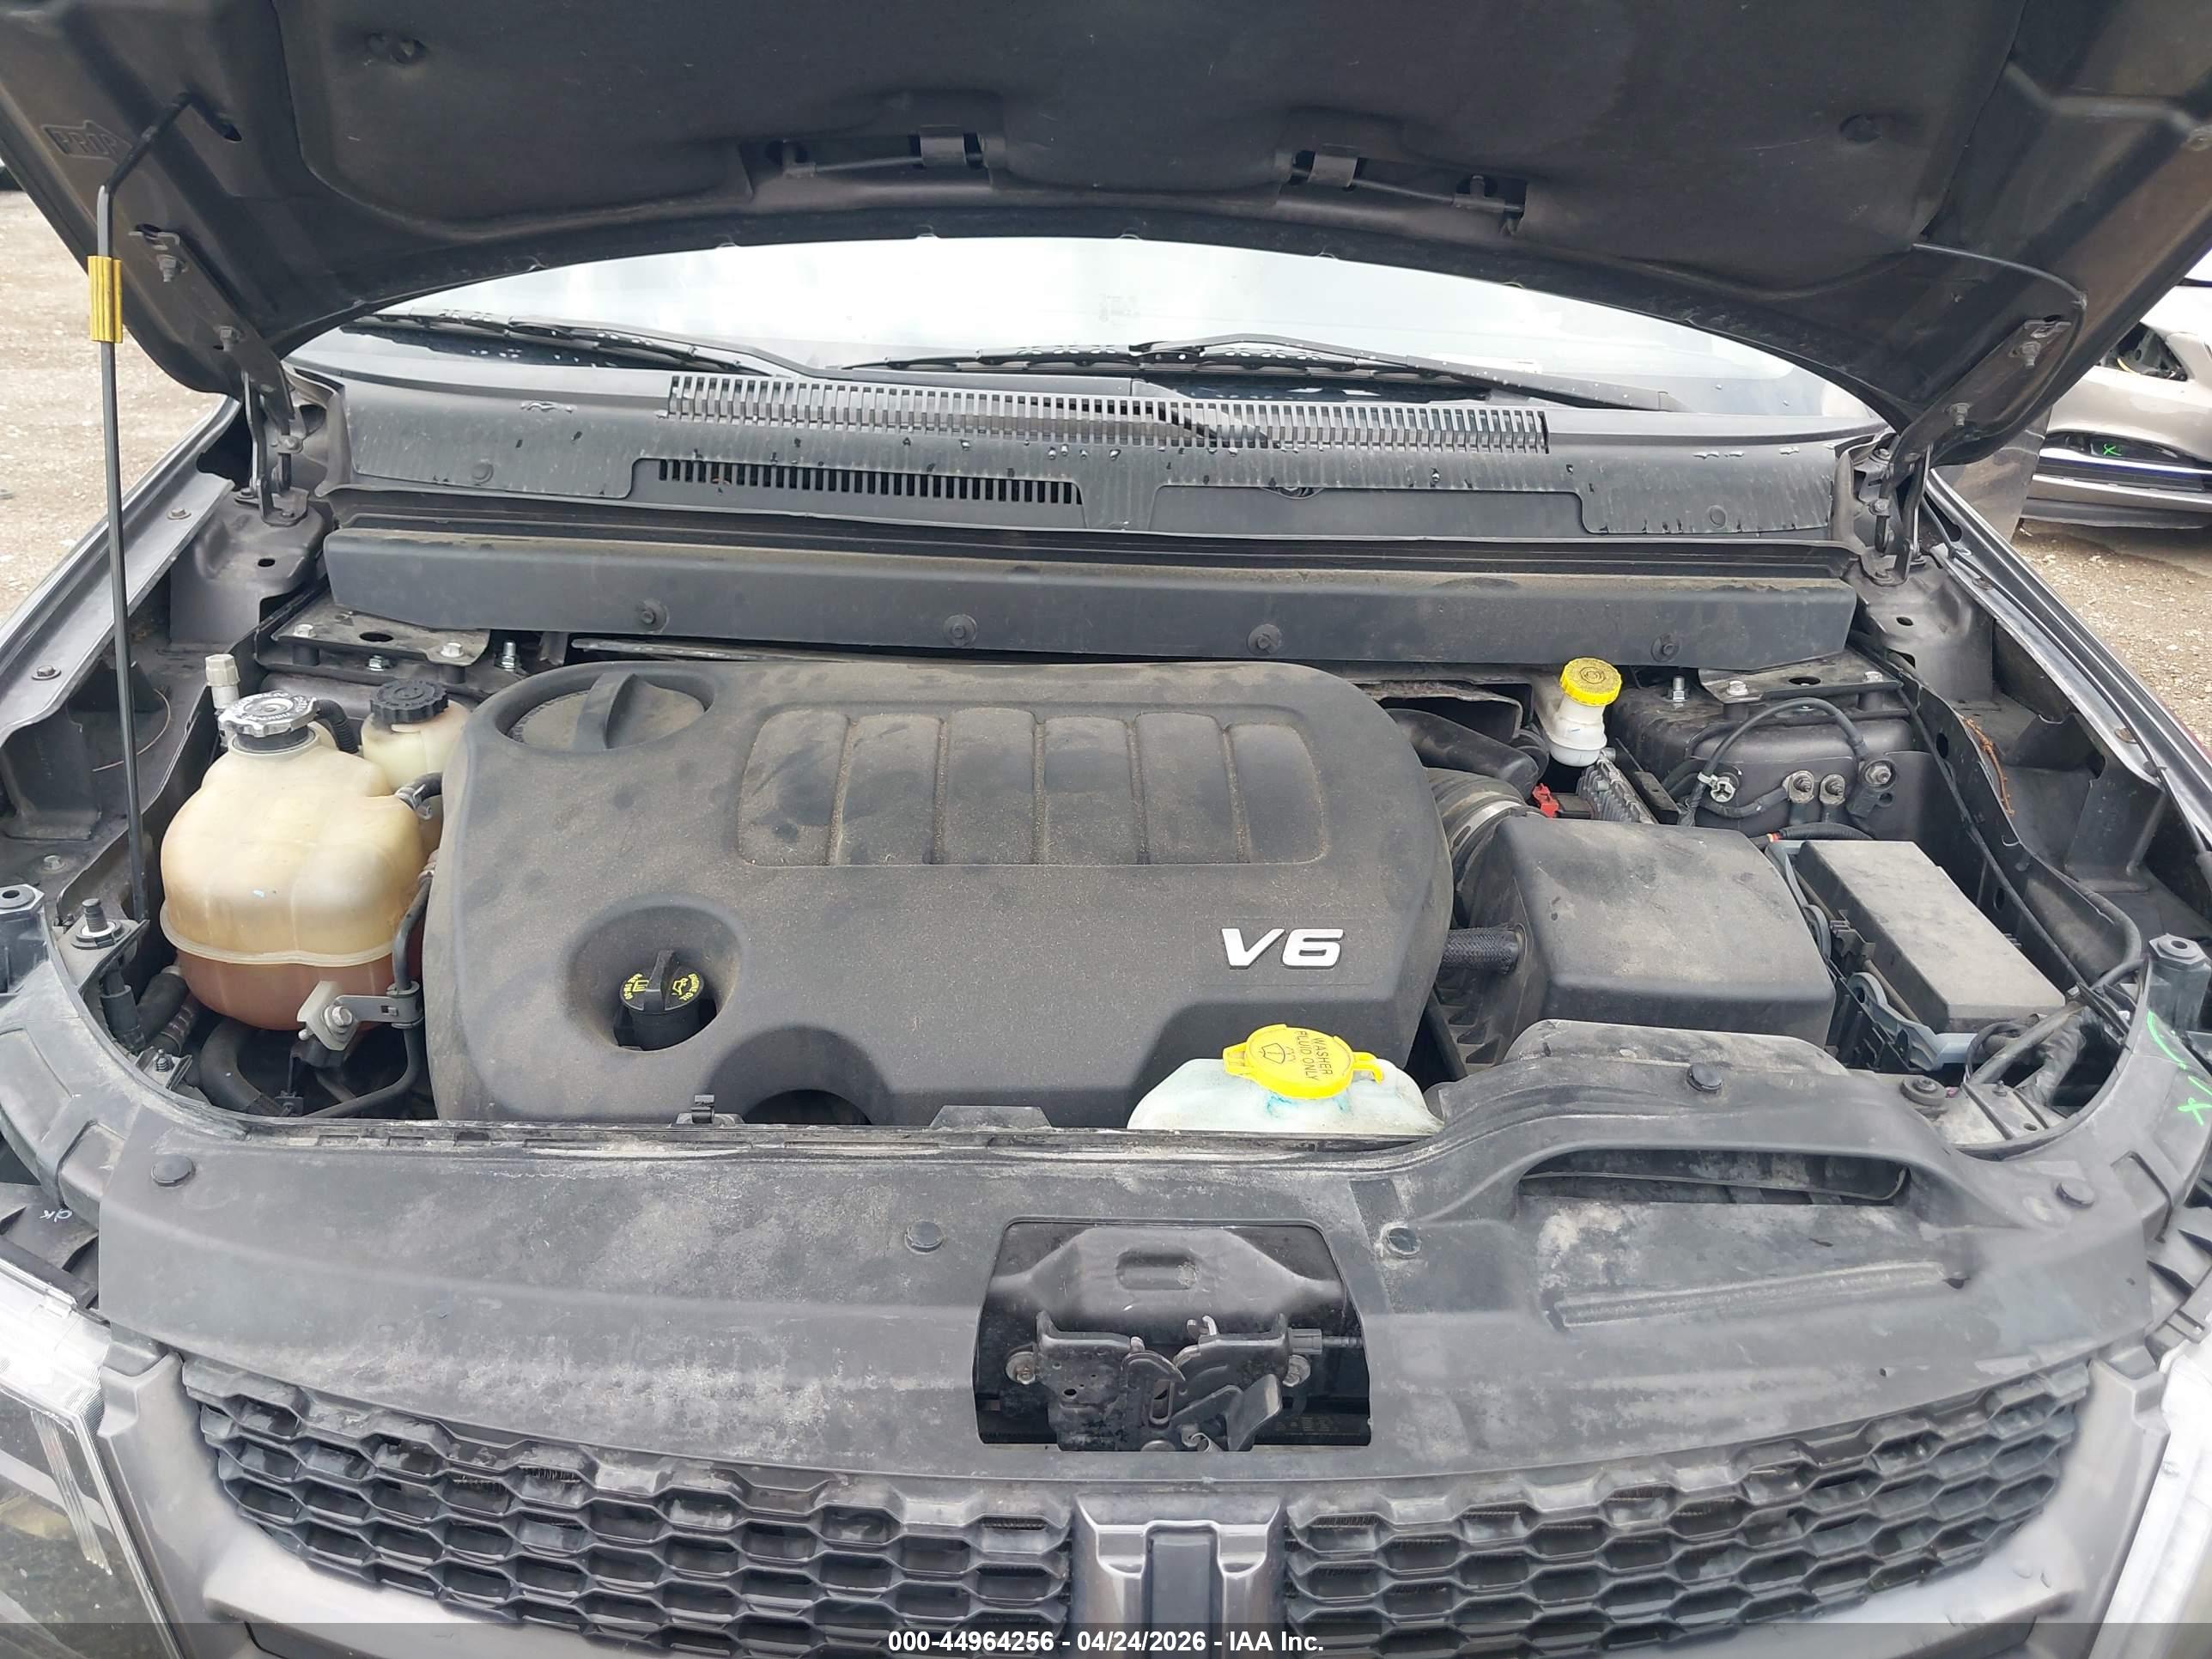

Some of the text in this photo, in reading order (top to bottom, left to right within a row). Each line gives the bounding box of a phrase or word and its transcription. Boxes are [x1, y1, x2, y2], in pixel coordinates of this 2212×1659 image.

[1221, 928, 1344, 968] V6
[678, 973, 700, 1001] ENGINE OIL
[1297, 1030, 1319, 1081] FLUID ONLY
[1313, 1037, 1334, 1075] WASHER
